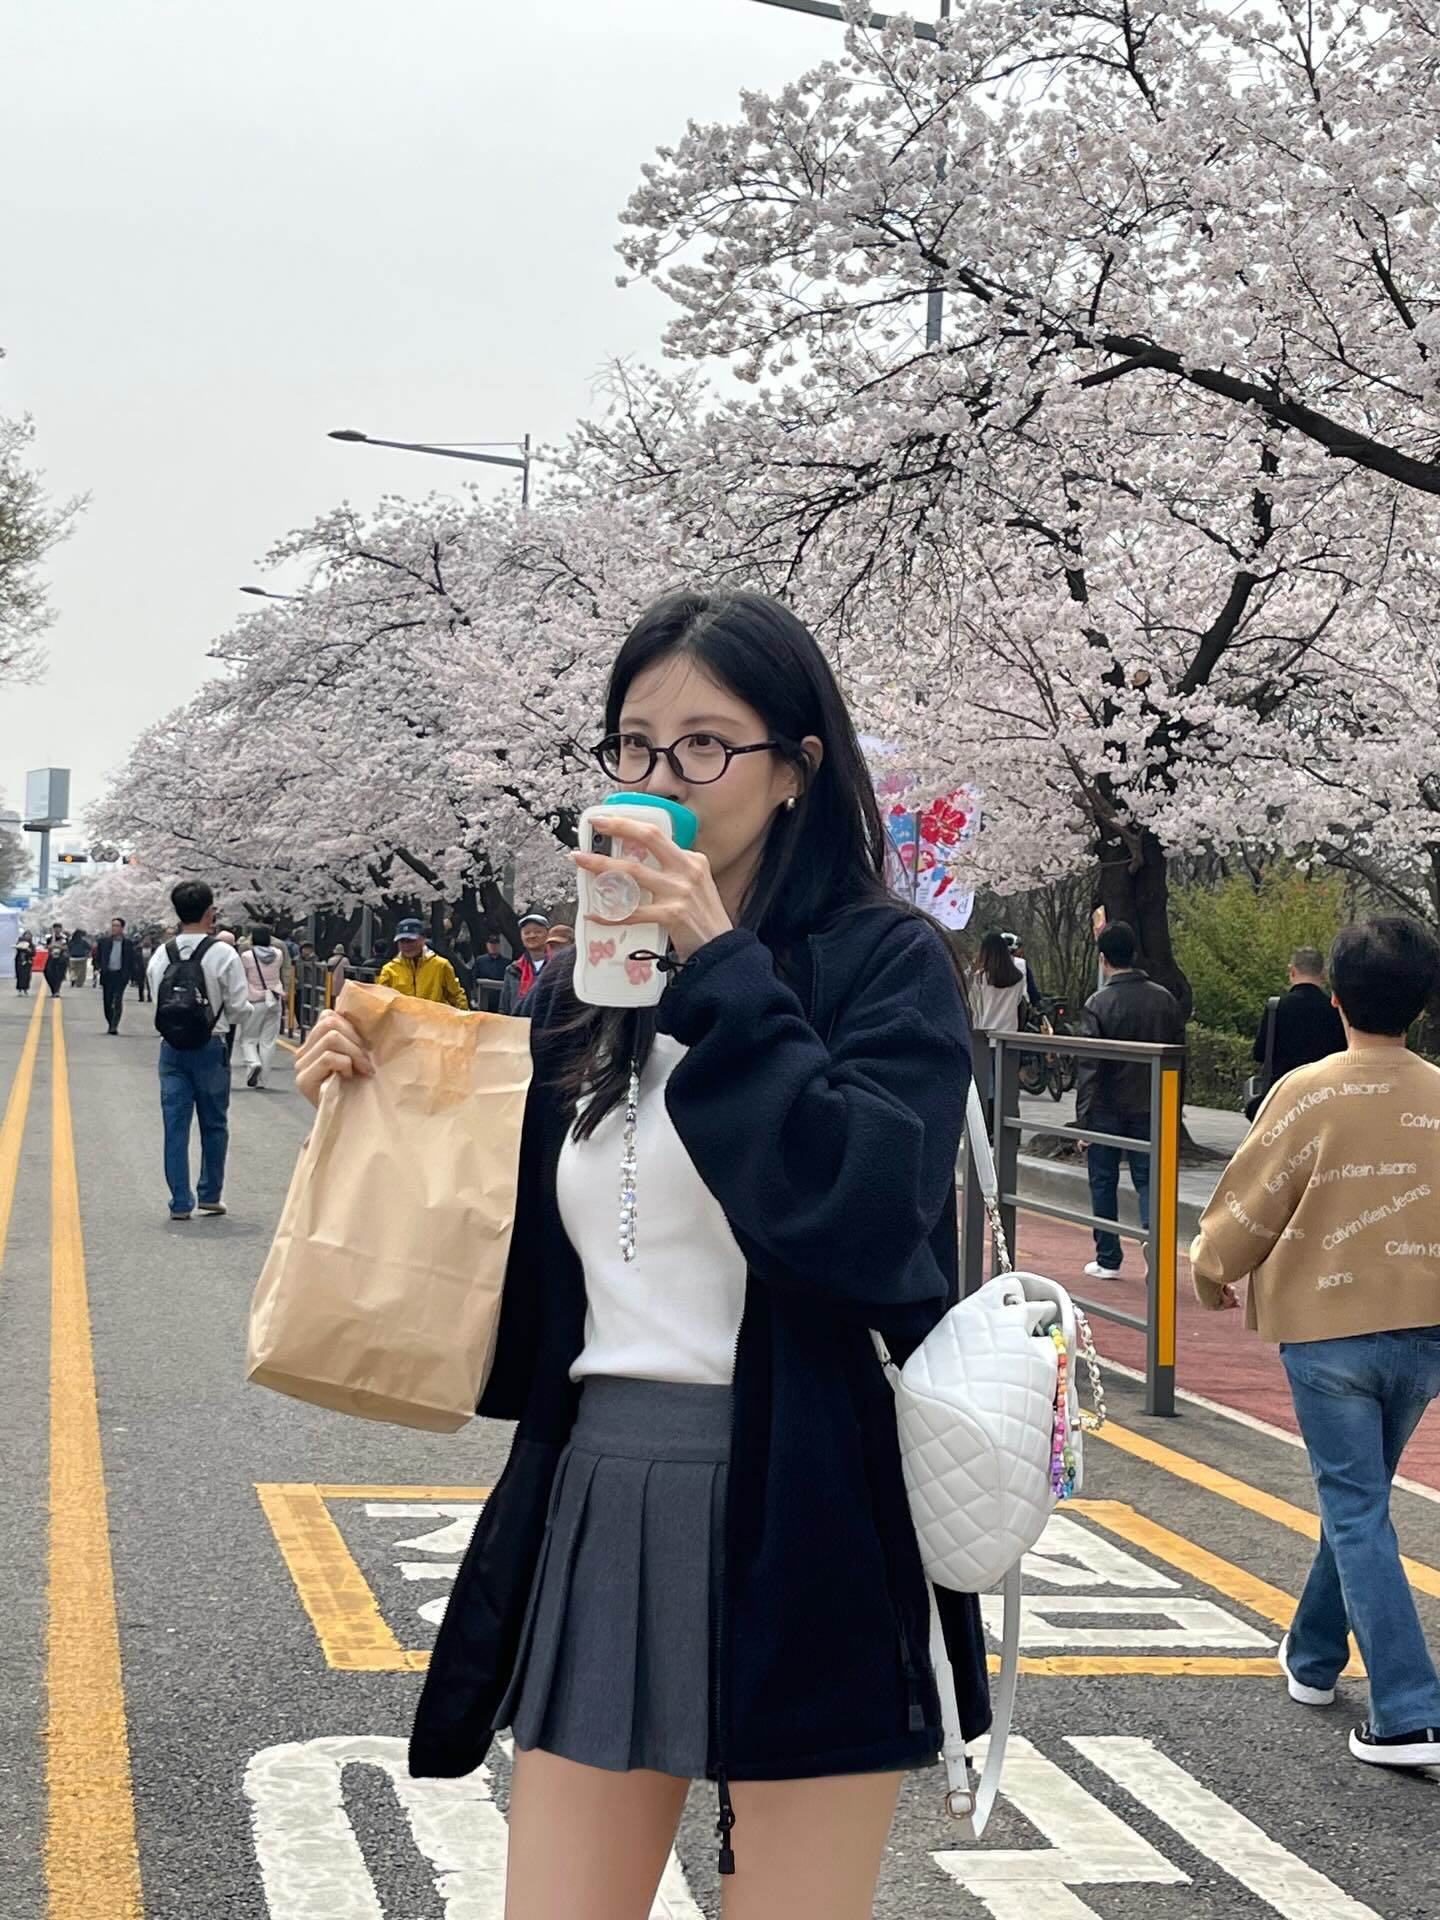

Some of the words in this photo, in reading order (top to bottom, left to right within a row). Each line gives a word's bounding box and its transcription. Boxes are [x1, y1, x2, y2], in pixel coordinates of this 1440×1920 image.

[1261, 1107, 1302, 1147] Calvin
[1299, 1086, 1337, 1112] Klein
[1339, 1082, 1390, 1097] Jeans
[1341, 1164, 1375, 1178] Klein
[1376, 1162, 1417, 1176] Jeans
[1322, 1218, 1364, 1250] Calvin
[1391, 1183, 1431, 1212] Jeans
[1315, 1270, 1354, 1292] Jeans
